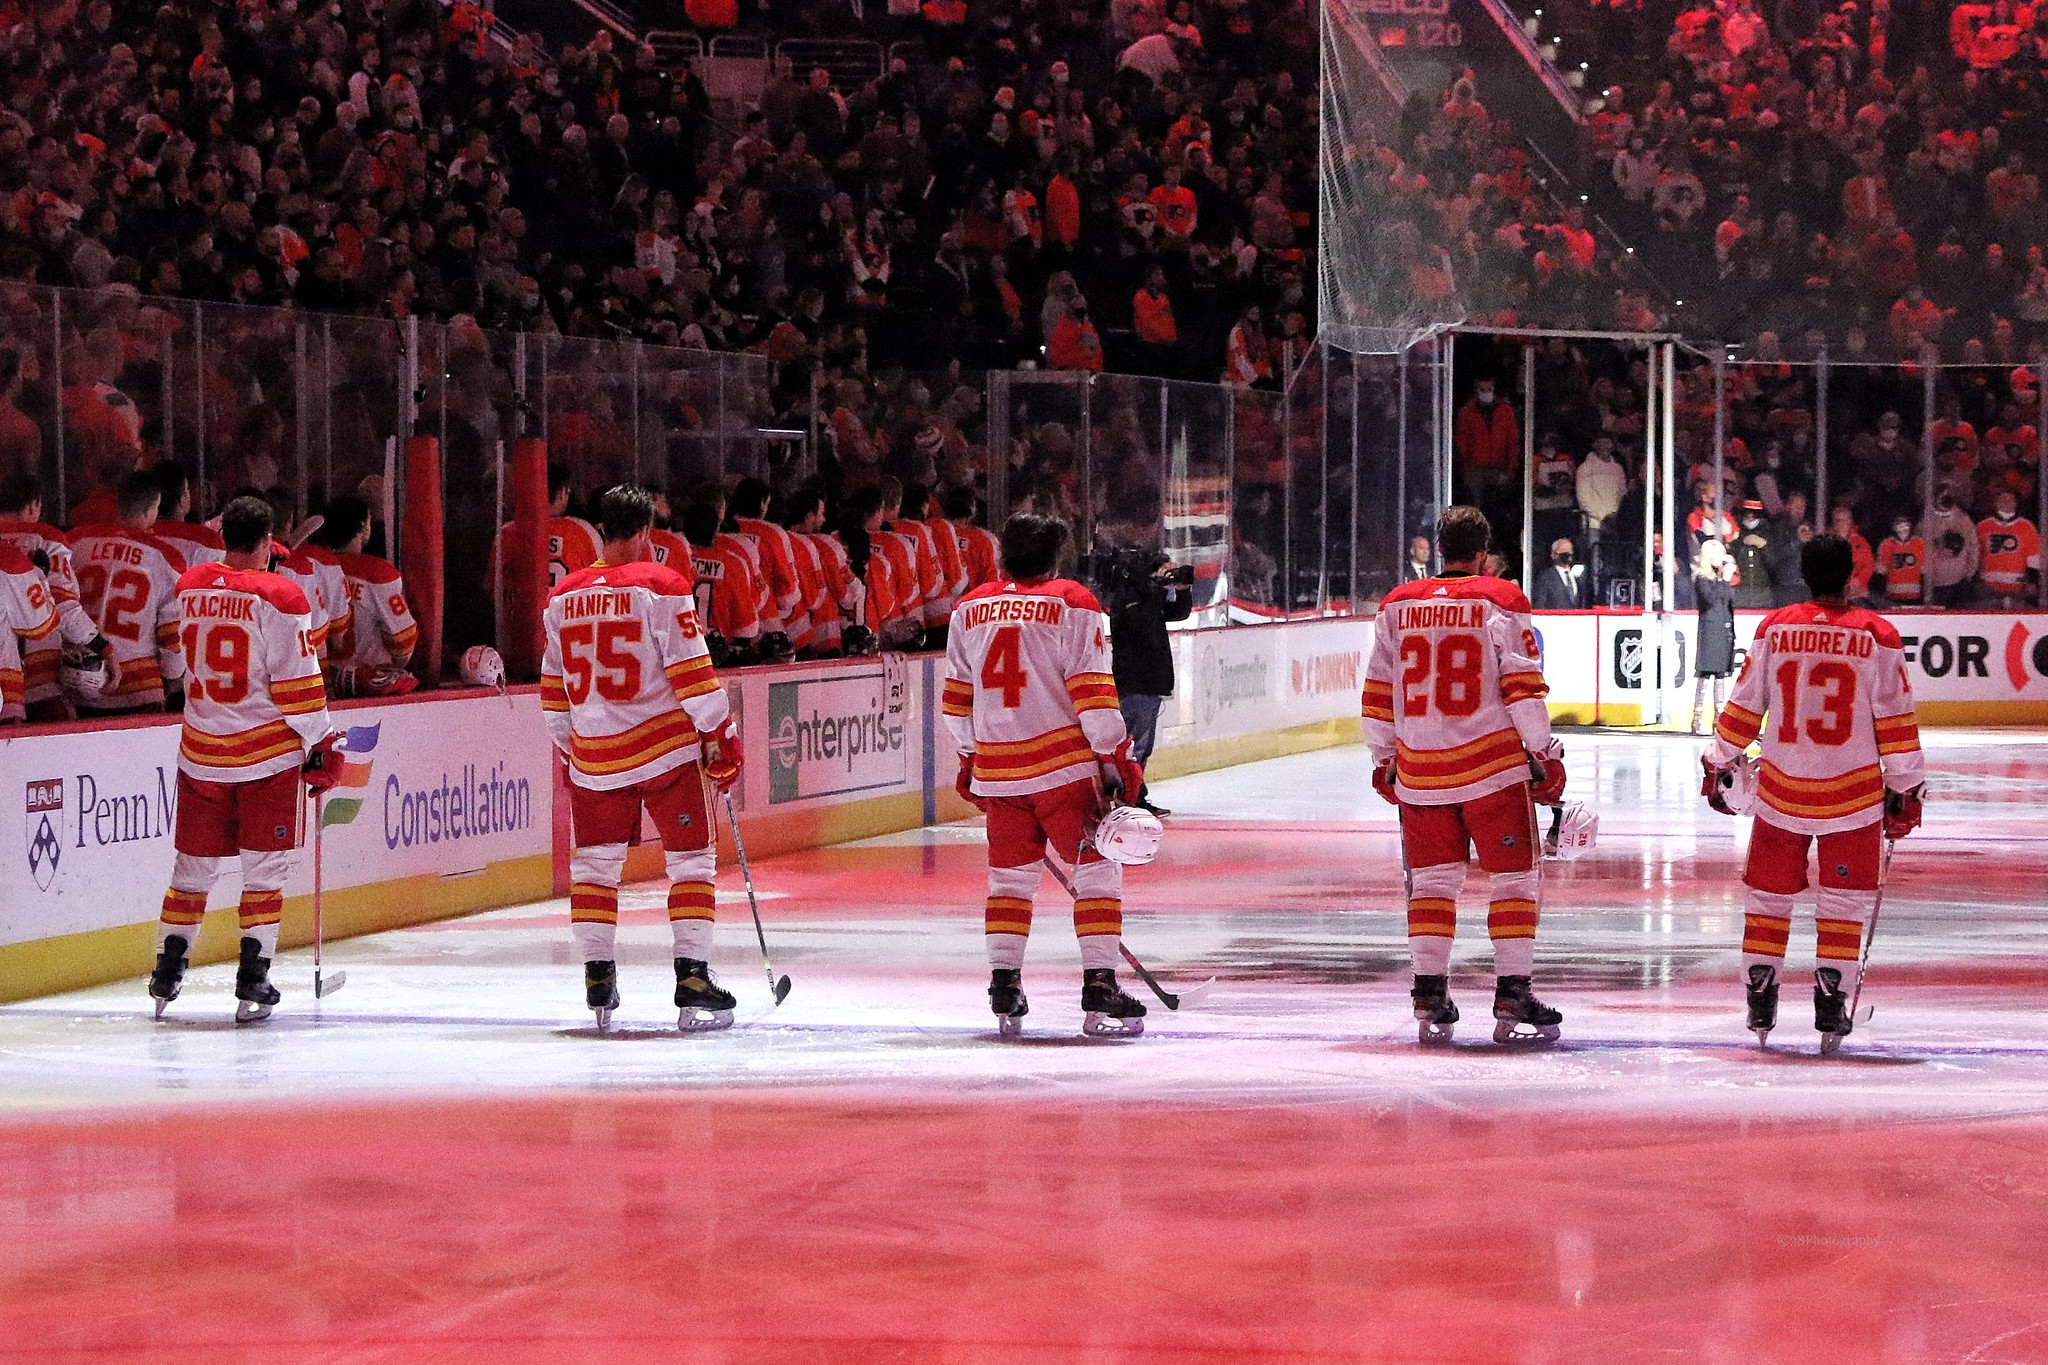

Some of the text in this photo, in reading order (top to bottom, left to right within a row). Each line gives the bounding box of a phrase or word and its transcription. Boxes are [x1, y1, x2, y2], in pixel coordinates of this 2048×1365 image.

[91, 542, 143, 565] LEWIS
[564, 592, 631, 620] HANIFIN
[965, 600, 1063, 632] ANDERSSON
[1398, 605, 1484, 631] LINDHOLM
[182, 623, 250, 704] 19
[560, 621, 642, 706] 55
[981, 626, 1028, 709] 4
[1400, 634, 1483, 717] 28
[1776, 659, 1857, 746] 13
[770, 697, 902, 773] enterprise
[76, 774, 150, 849] Penn
[384, 760, 530, 850] Constellation
